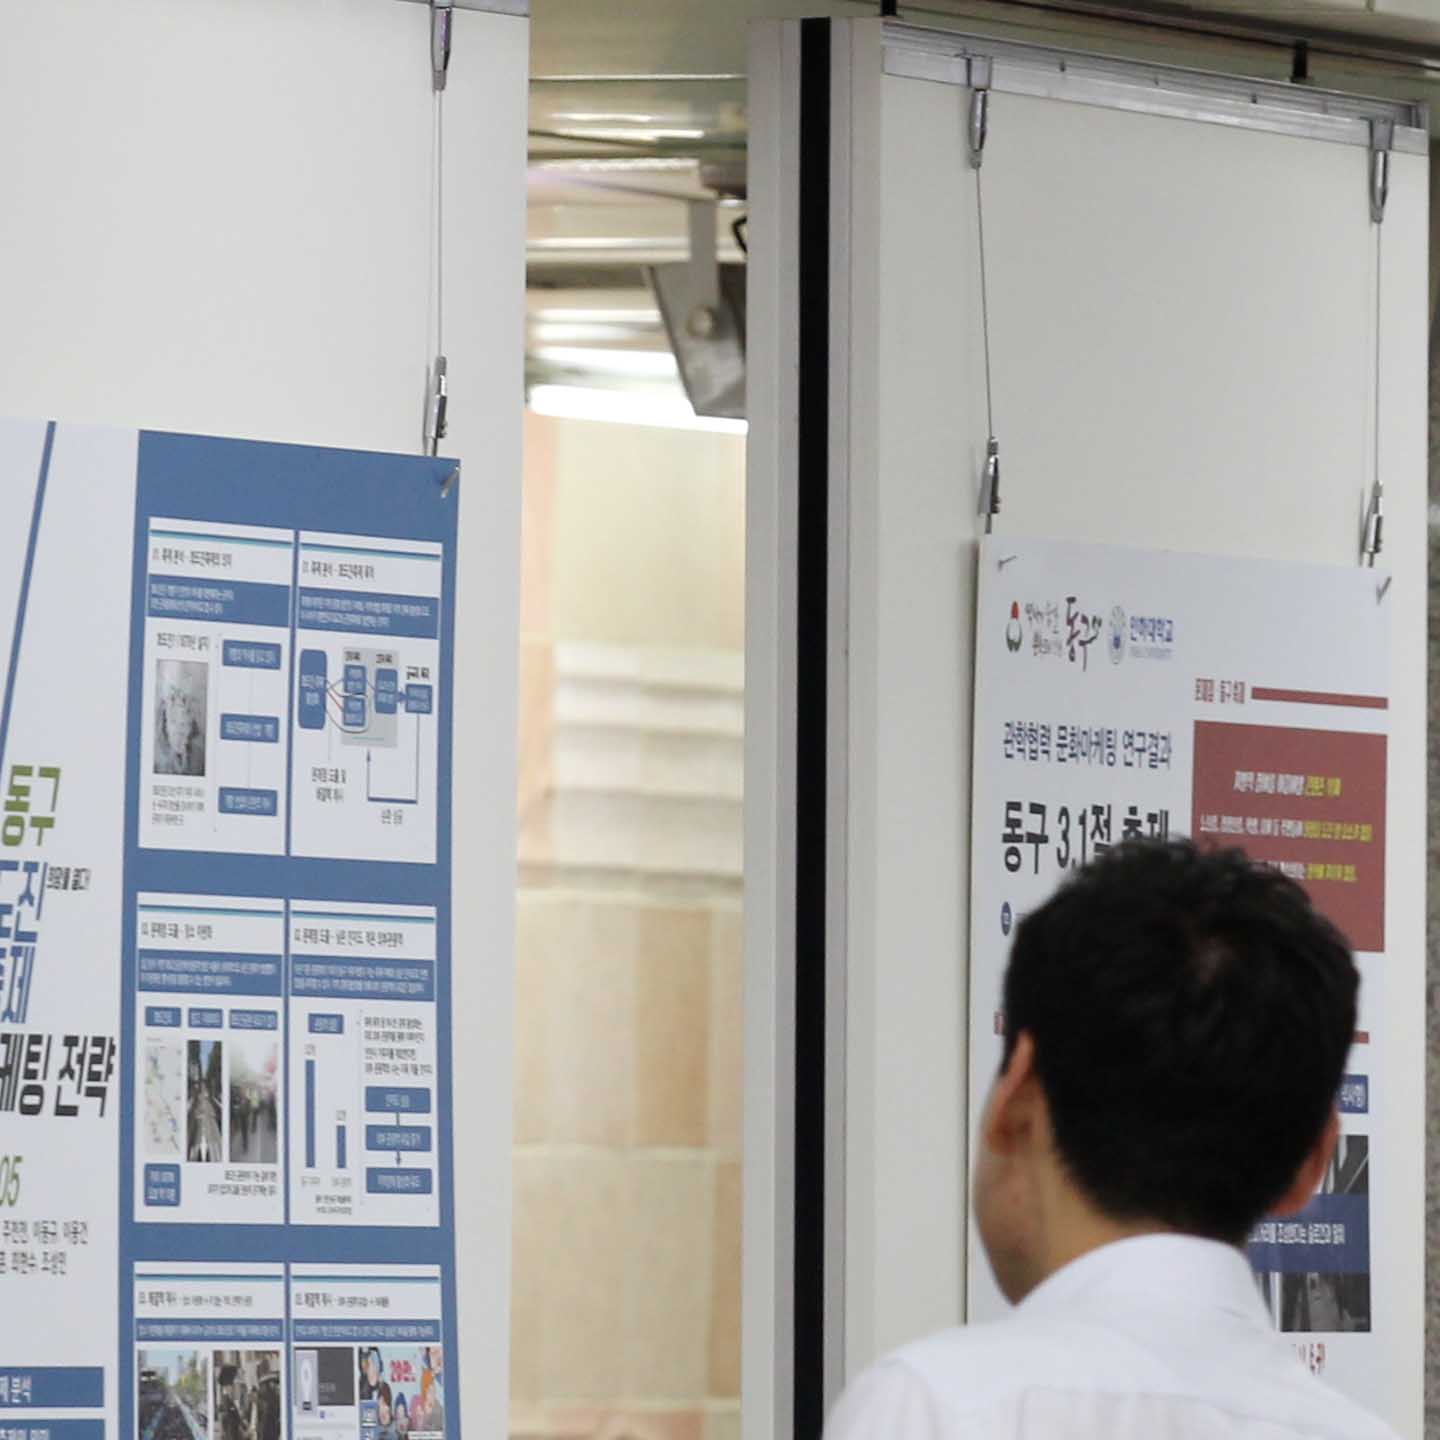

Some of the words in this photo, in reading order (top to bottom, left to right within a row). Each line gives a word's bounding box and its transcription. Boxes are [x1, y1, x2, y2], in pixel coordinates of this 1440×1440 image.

[1130, 616, 1174, 643] 인하대학교
[1003, 721, 1052, 762] 관학협력
[1056, 725, 1117, 767] 문화마케팅
[1123, 729, 1172, 770] 연구결과
[2, 764, 61, 846] 동구
[1001, 801, 1048, 874] 동구
[53, 1033, 116, 1117] 전략
[11, 1375, 32, 1403] 분석
